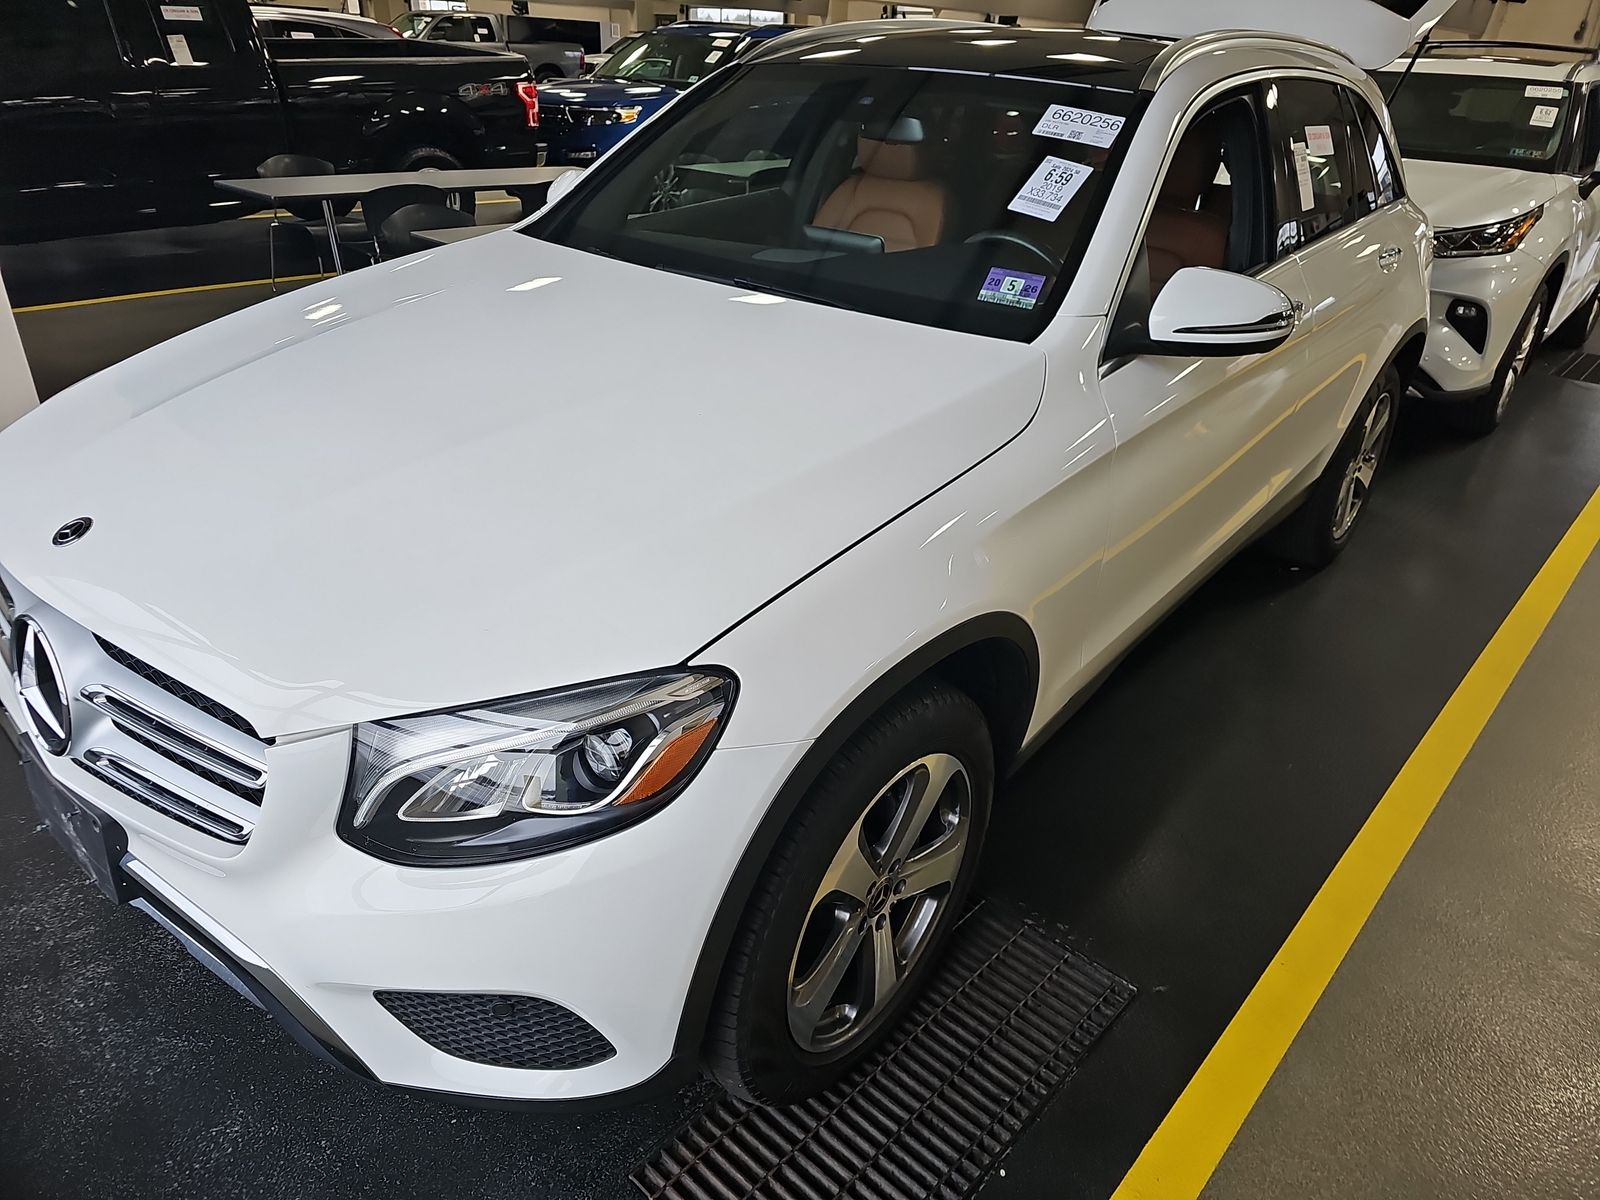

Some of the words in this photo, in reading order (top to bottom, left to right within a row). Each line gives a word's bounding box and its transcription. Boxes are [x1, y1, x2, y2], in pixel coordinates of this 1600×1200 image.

[1041, 122, 1059, 130] DLR
[1052, 108, 1122, 131] 6620256
[1044, 168, 1074, 186] 6:59
[1040, 181, 1064, 193] 2019
[987, 277, 1001, 287] 20
[1007, 279, 1017, 292] 5
[1023, 284, 1039, 294] 26
